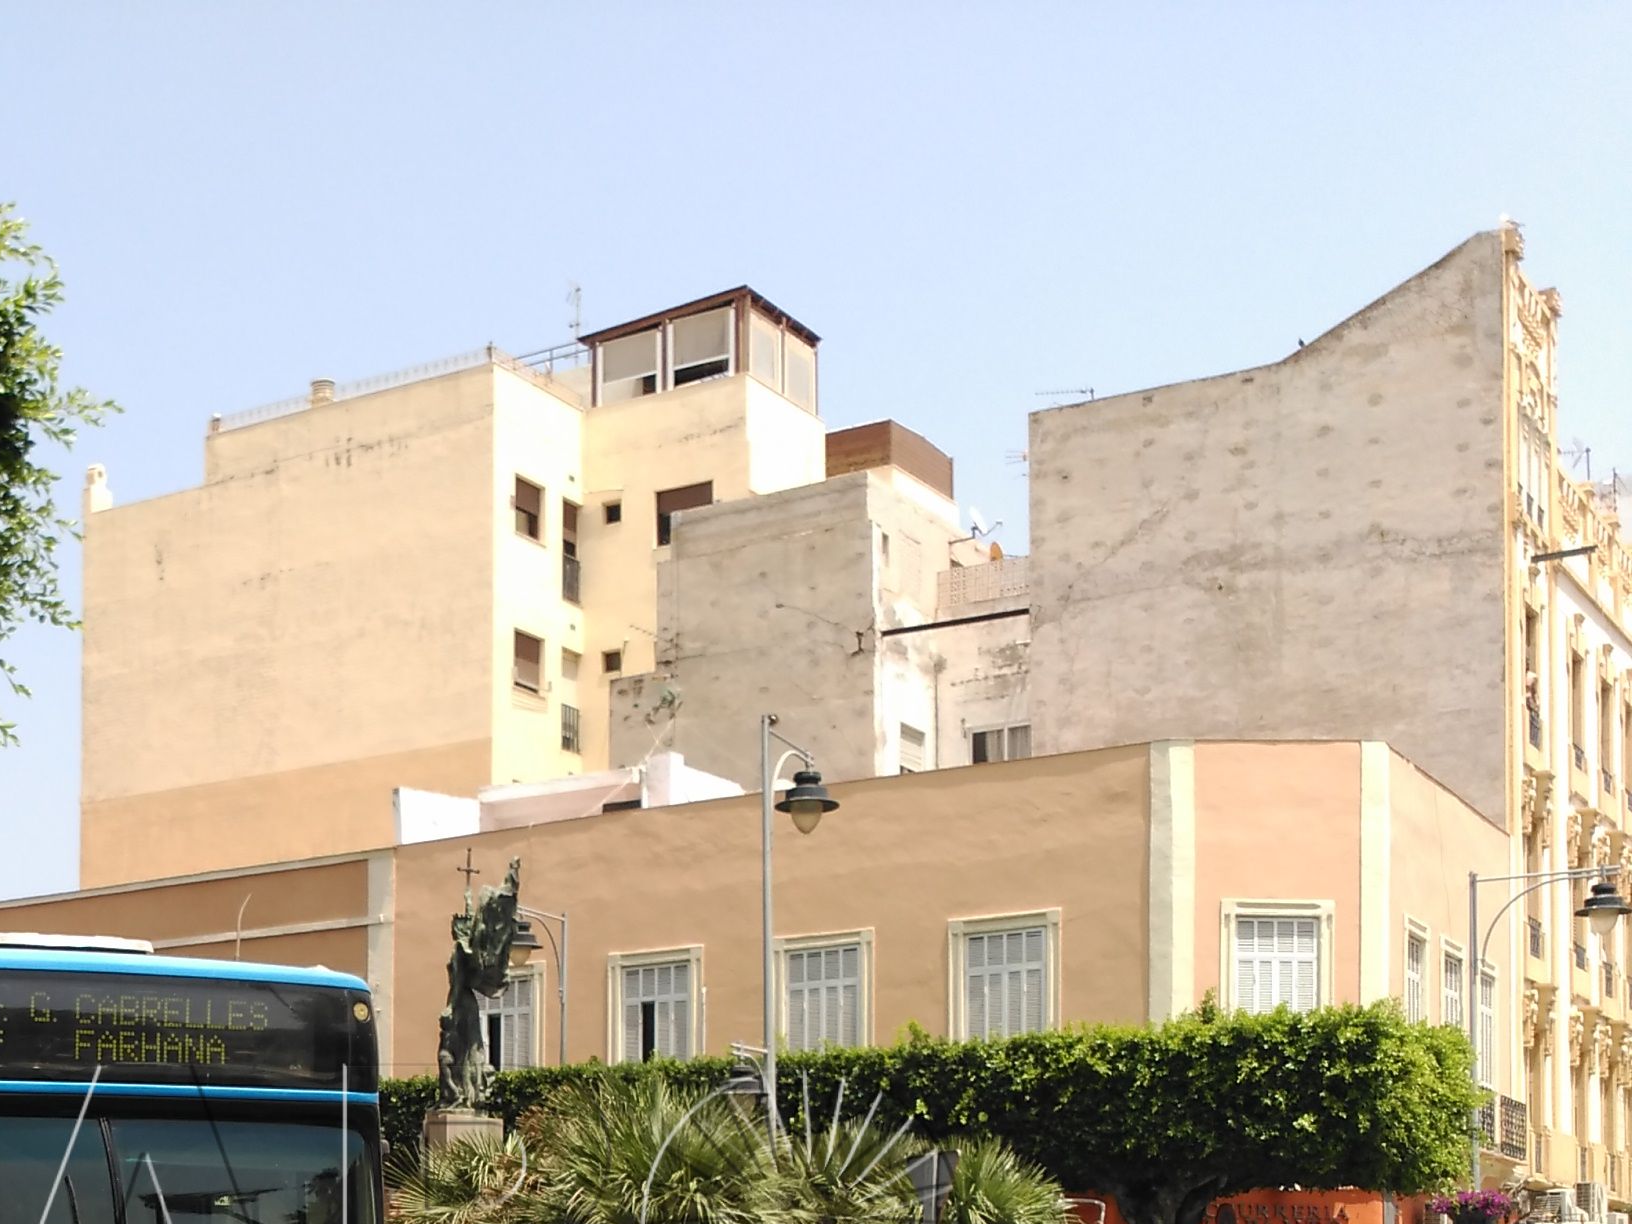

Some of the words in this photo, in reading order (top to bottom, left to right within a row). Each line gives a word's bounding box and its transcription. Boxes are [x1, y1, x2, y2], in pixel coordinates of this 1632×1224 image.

[74, 993, 268, 1031] CABRELLES
[74, 1029, 226, 1066] FARHANA
[1205, 1201, 1349, 1223] CURRERIA
